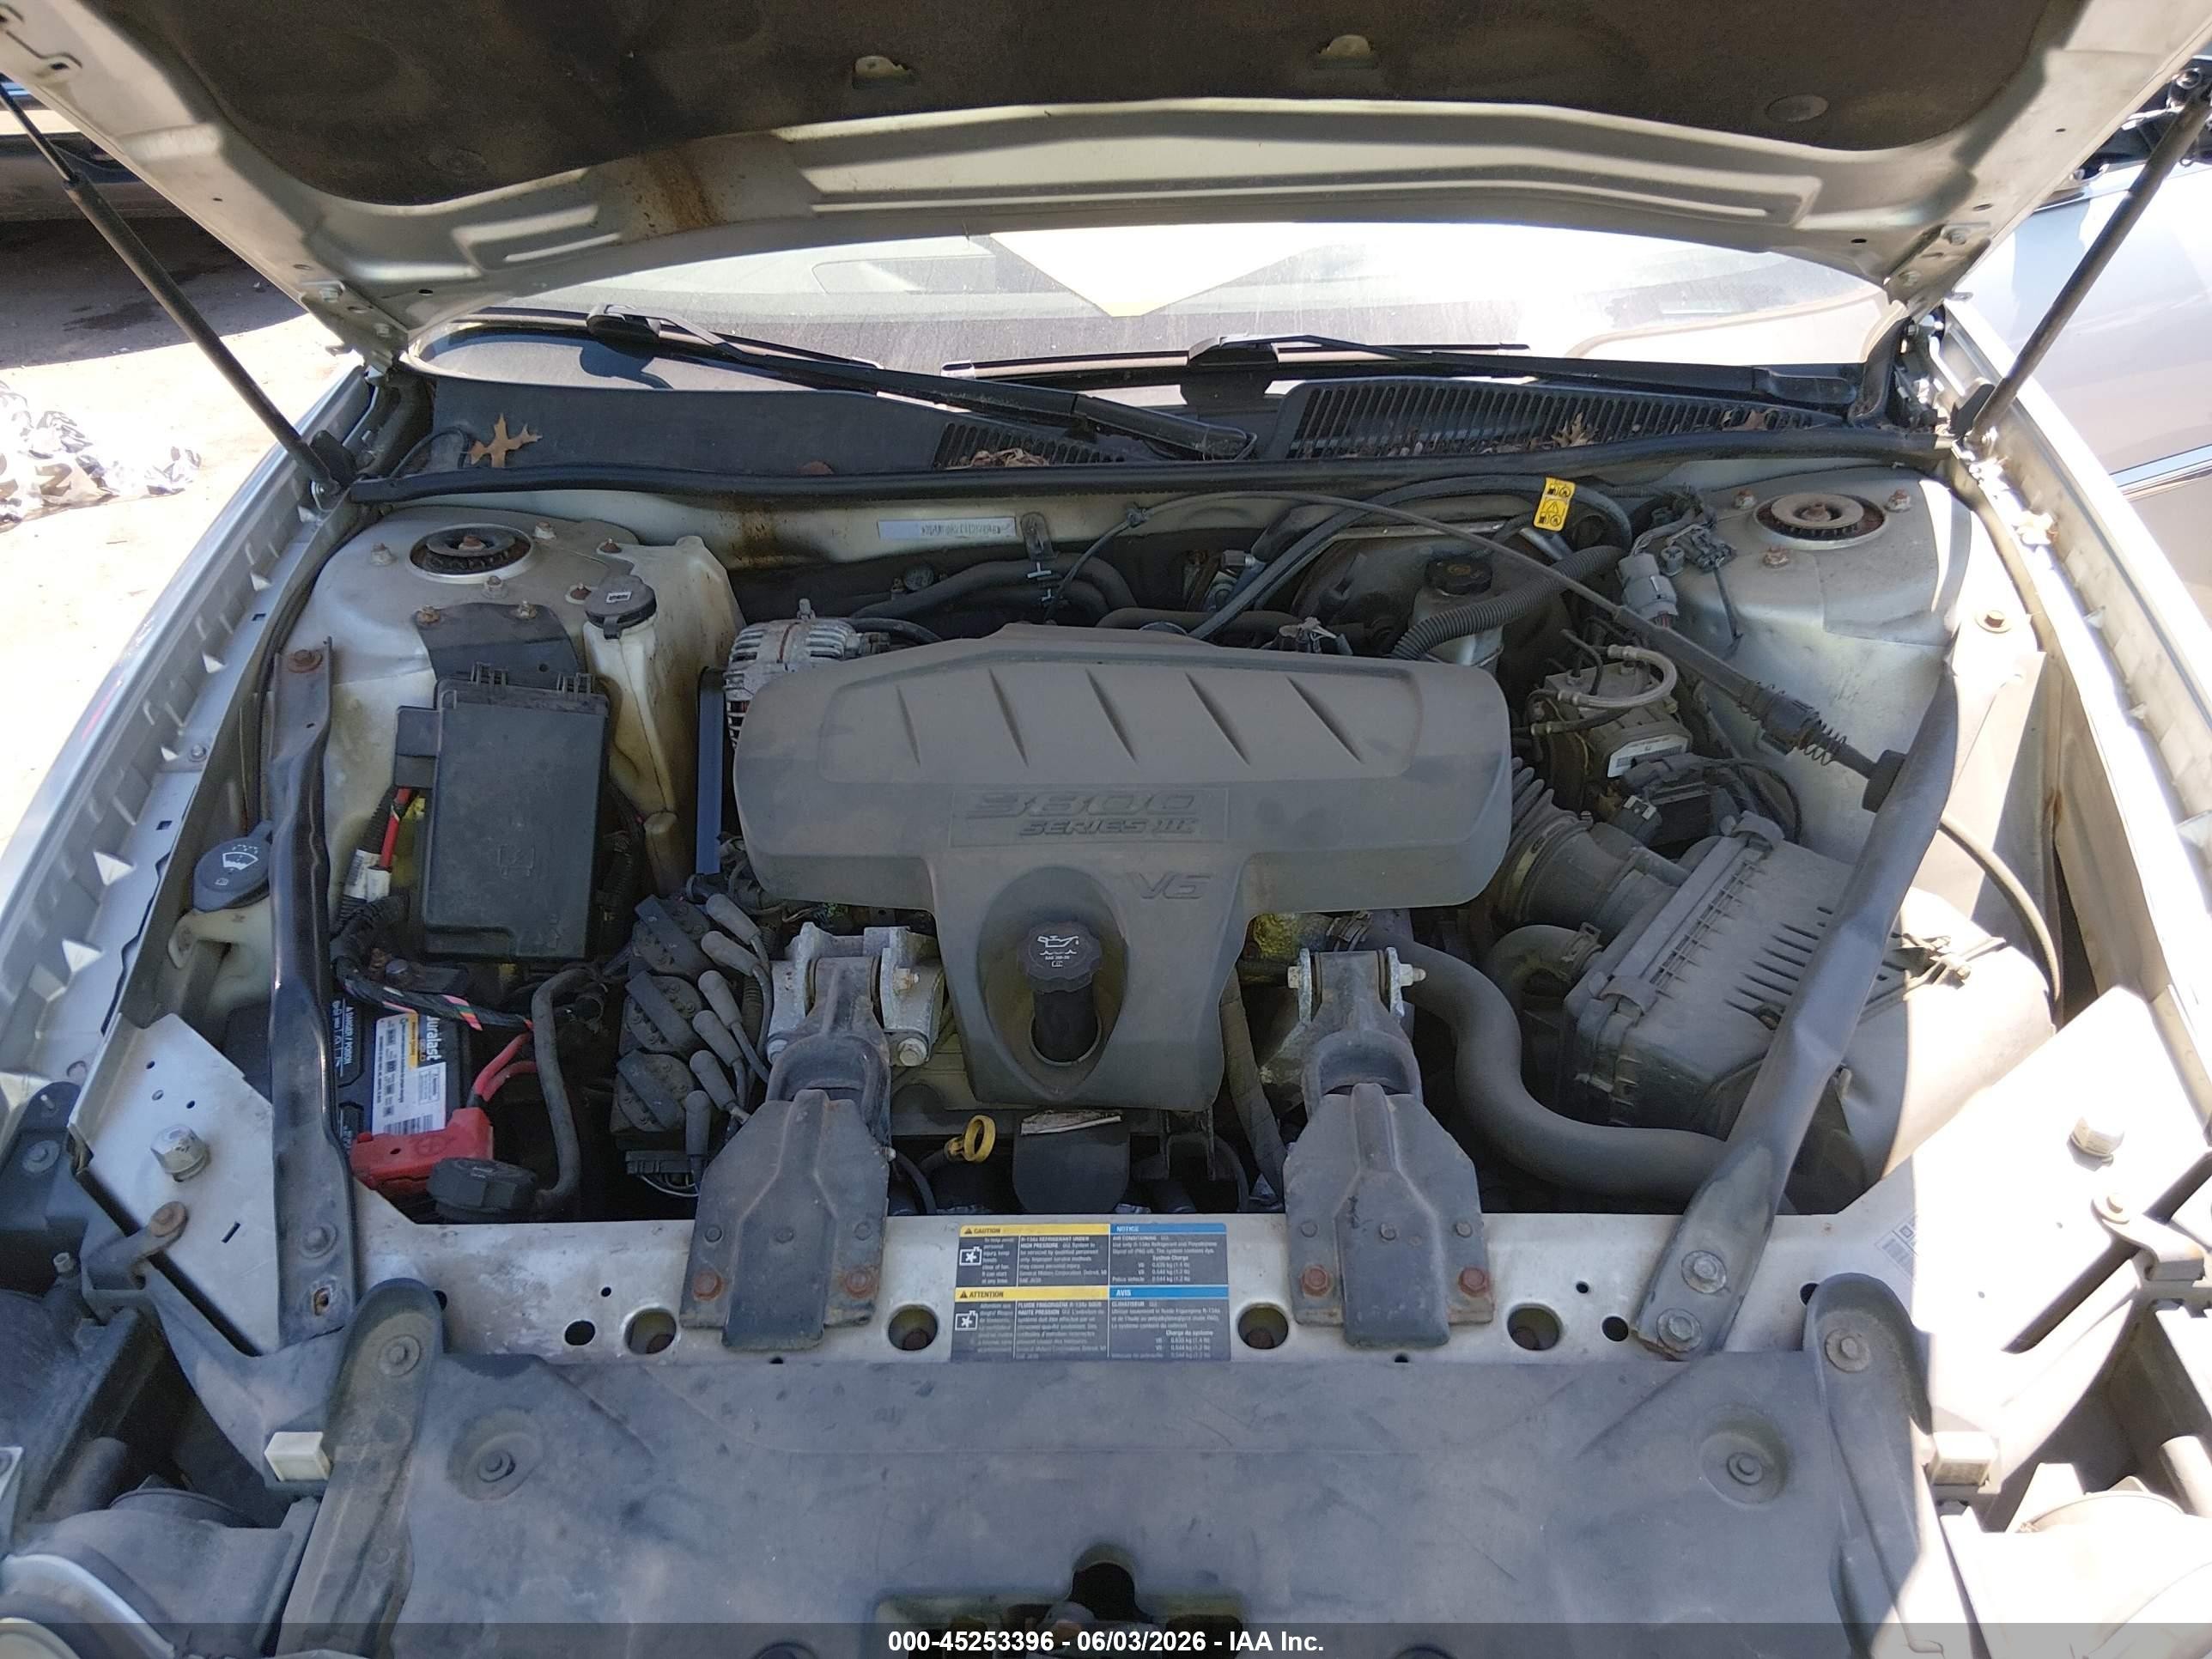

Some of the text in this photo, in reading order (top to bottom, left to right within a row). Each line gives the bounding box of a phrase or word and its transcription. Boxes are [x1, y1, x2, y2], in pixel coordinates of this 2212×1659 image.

[966, 792, 1196, 818] 3800
[1020, 817, 1197, 836] SERIES III
[1127, 872, 1212, 900] V6
